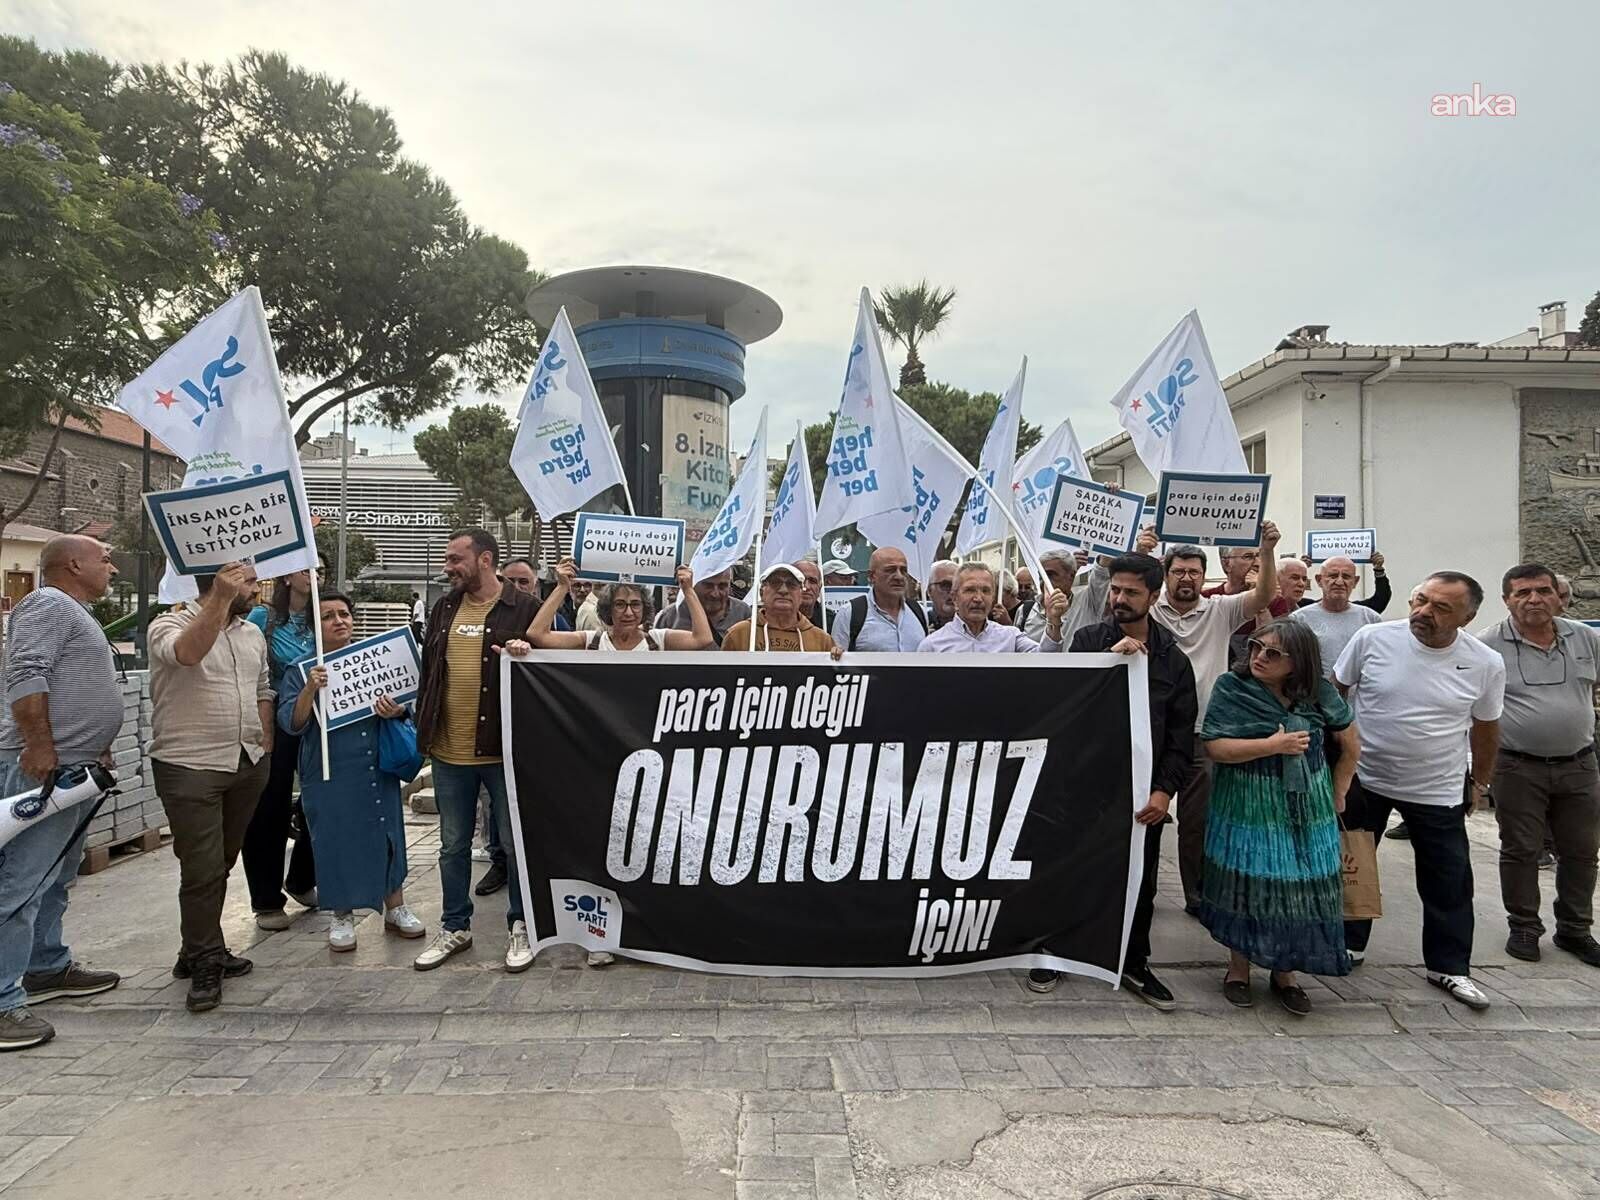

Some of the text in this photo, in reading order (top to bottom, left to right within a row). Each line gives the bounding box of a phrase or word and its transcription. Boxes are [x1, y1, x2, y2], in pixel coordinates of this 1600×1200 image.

[675, 433, 695, 454] 8.
[1075, 489, 1122, 509] SADAKA
[1169, 492, 1260, 505] para için değil
[166, 493, 287, 527] İNSANCA BİR
[1077, 501, 1115, 520] DEĞİL,
[1166, 505, 1257, 520] ONURUMUZ
[201, 514, 267, 537] YAŞAM
[1056, 518, 1125, 546] İSTİYORUZ!
[1062, 510, 1124, 534] HAKKIMIZI
[1216, 521, 1243, 531] İÇİN!
[185, 524, 283, 555] İSTİYORUZ
[586, 528, 677, 542] para için değil
[583, 540, 675, 557] ONURUMUZ
[634, 556, 661, 568] İÇİN!
[332, 645, 391, 672] SADAKA
[342, 659, 390, 681] DEĞİL,
[332, 665, 409, 699] HAKKIMIZI
[331, 675, 417, 713] İSTİYORUZ!
[652, 674, 870, 743] para için değil
[606, 738, 1048, 886] ONURUMUZ
[563, 895, 608, 916] SOL
[577, 912, 607, 928] PARTİ
